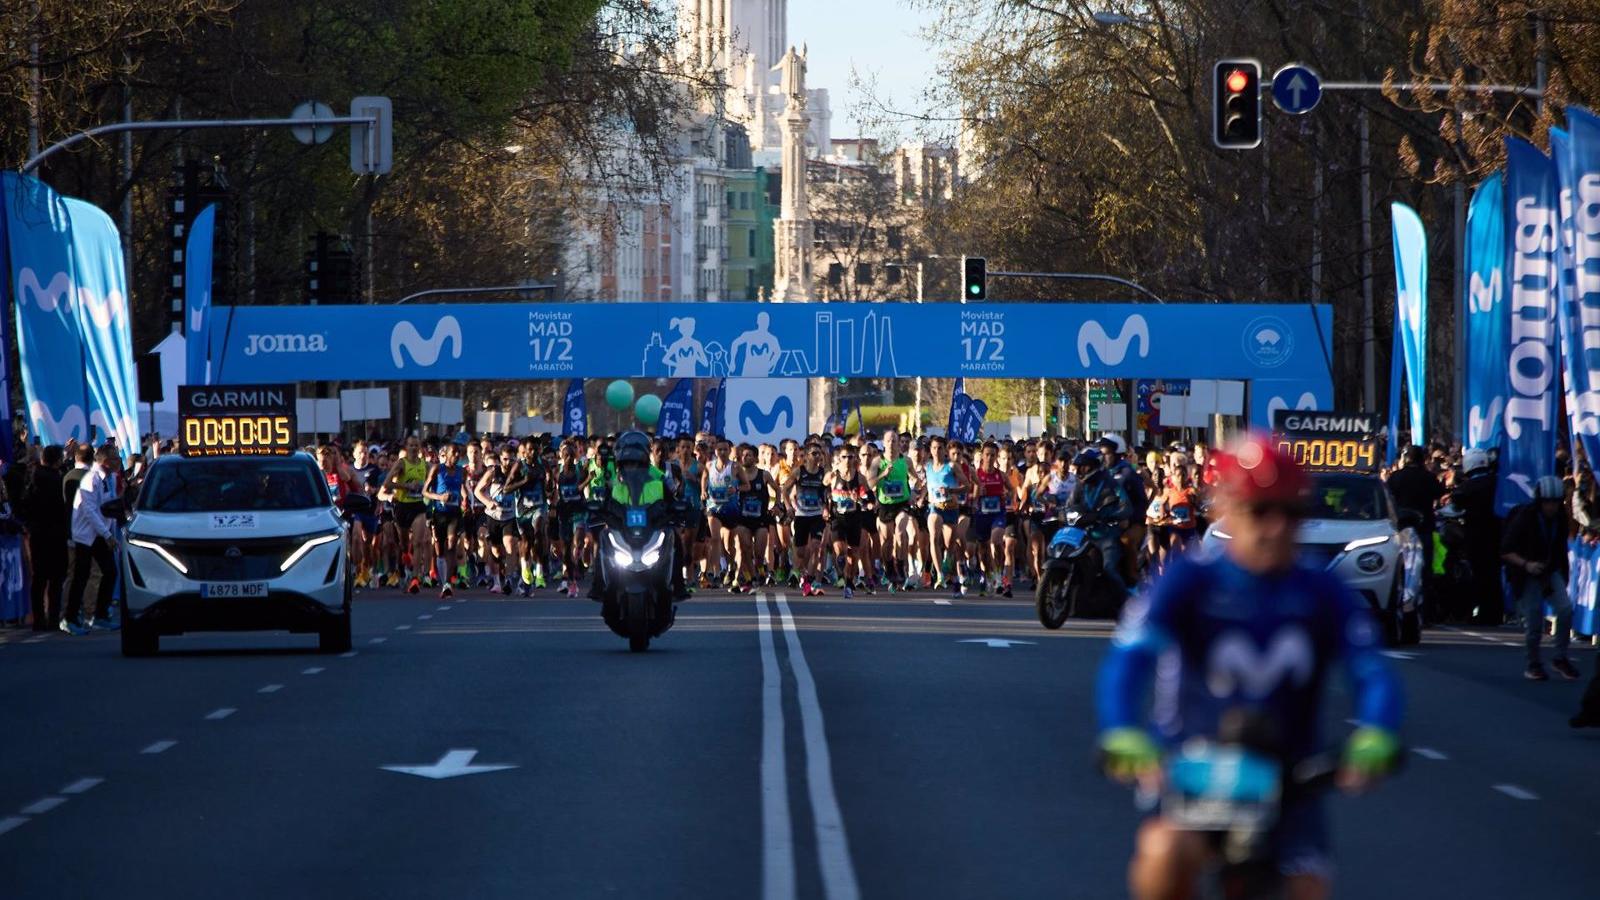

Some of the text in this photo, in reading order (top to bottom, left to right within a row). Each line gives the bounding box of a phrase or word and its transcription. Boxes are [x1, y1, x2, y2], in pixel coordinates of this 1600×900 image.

[528, 311, 572, 321] Movistar
[961, 311, 1005, 320] Movistar
[529, 322, 573, 336] MAD
[961, 321, 1005, 336] MAD
[529, 338, 573, 361] 1/2
[961, 337, 1005, 361] 1/2
[529, 362, 573, 371] MARATÓN
[961, 362, 1005, 371] MARATÓN
[191, 391, 284, 407] GARMIN
[1285, 416, 1371, 433] GARMIN
[209, 583, 264, 596] 4878 MDF
